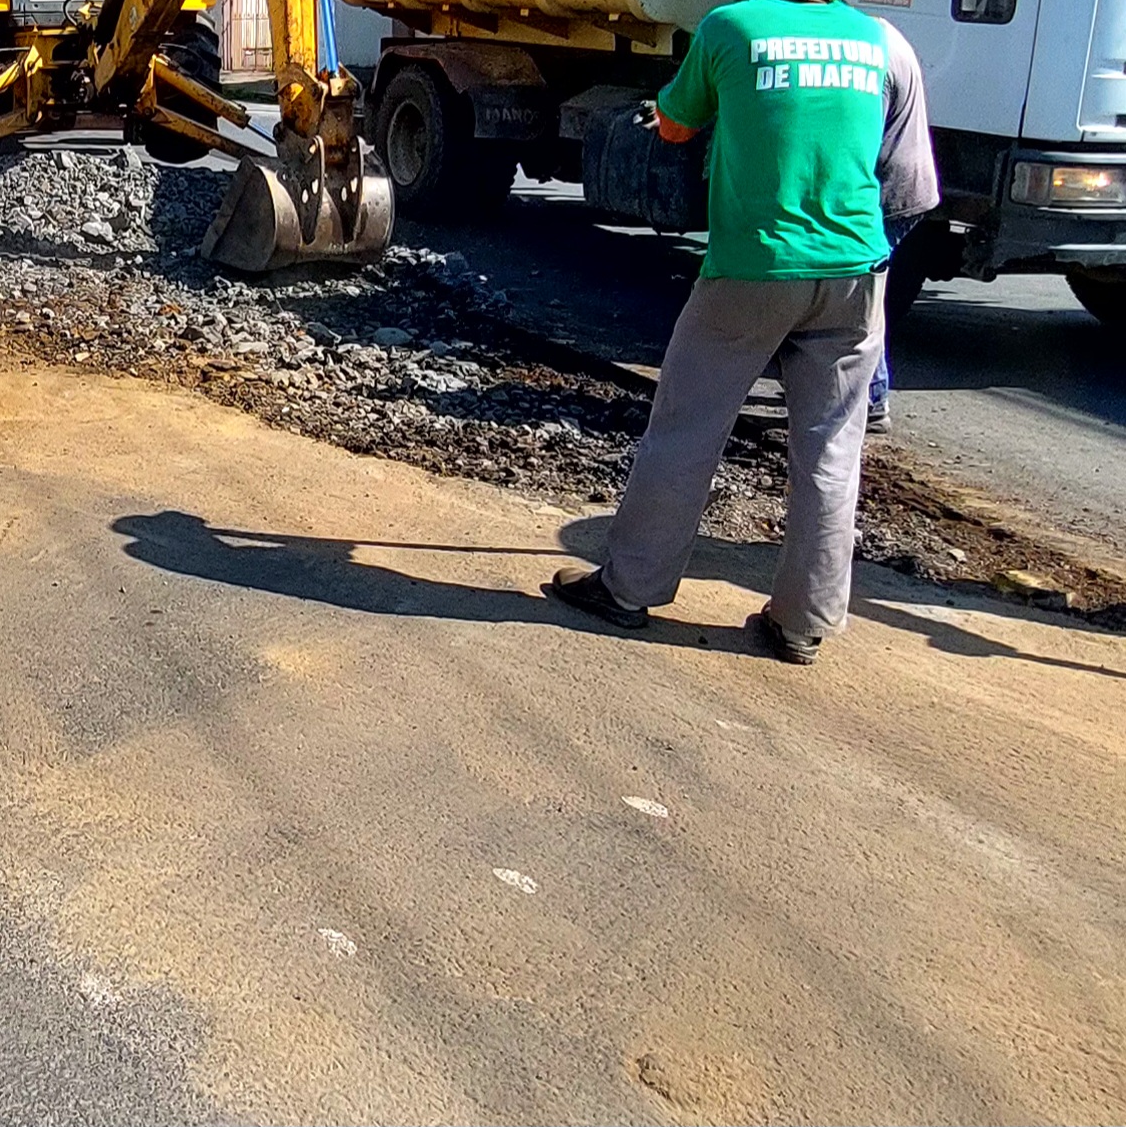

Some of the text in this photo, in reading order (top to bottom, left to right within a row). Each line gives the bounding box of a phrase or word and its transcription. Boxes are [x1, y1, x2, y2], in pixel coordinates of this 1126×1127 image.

[750, 36, 885, 70] PREFEITURA
[755, 63, 879, 96] DE MAFRA
